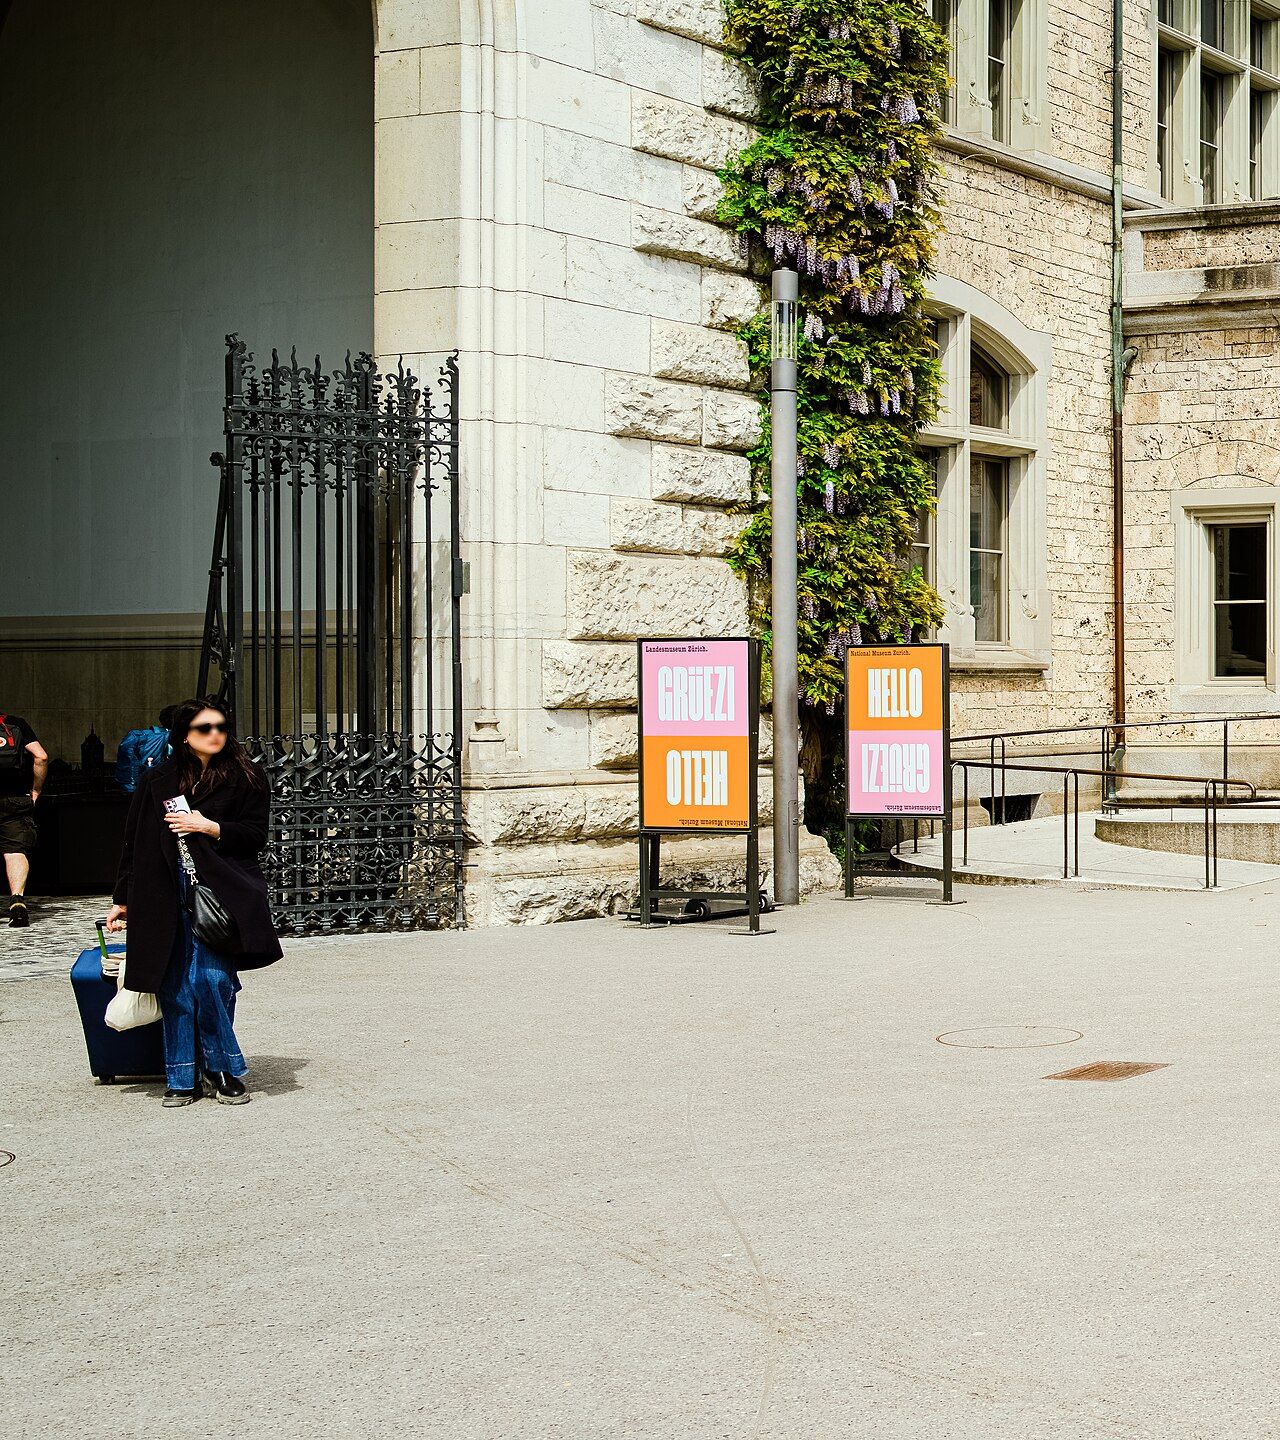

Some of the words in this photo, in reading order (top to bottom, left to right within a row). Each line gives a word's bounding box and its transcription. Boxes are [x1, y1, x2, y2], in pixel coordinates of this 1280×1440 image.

[657, 665, 735, 722] GRÜEZI
[867, 667, 923, 719] HELLO
[666, 750, 729, 806] HELLO
[861, 743, 931, 794] GRÜEZI
[700, 819, 724, 827] Museum
[904, 804, 942, 812] Landesmuseum
